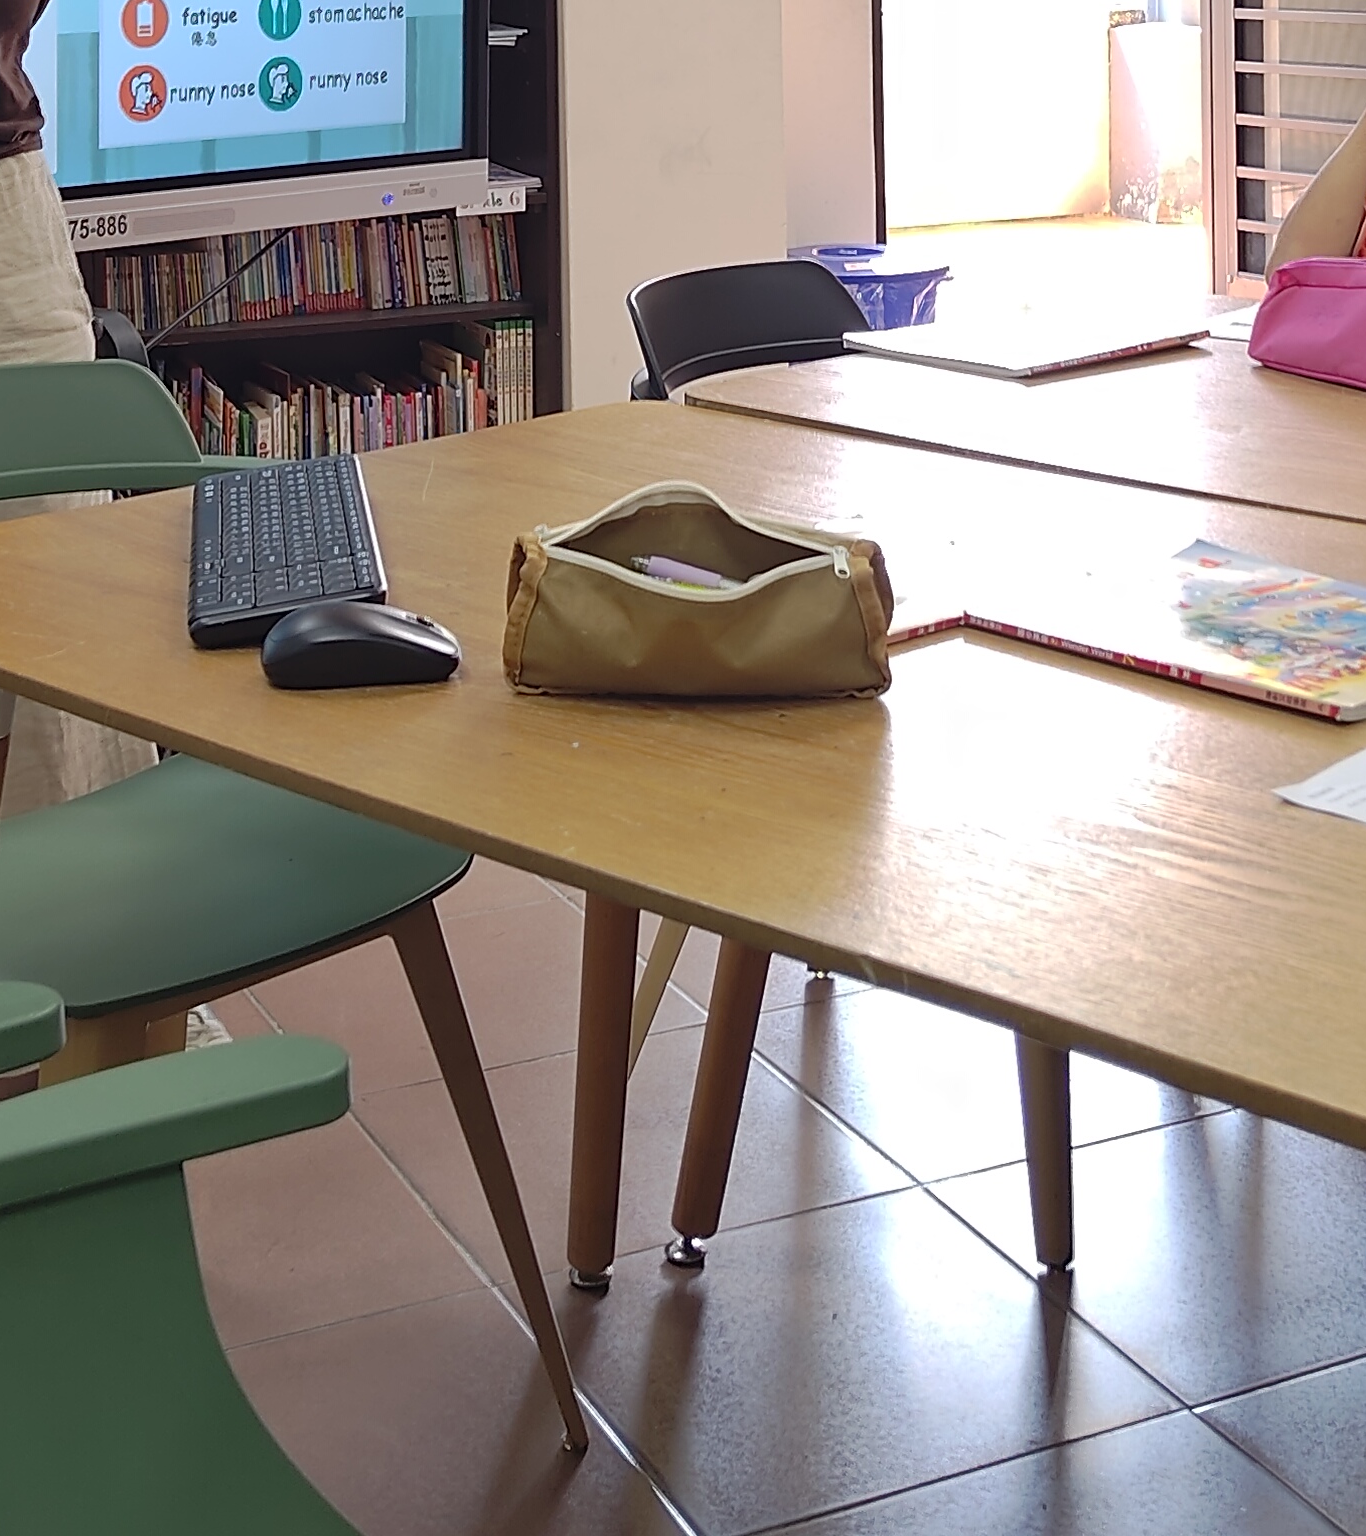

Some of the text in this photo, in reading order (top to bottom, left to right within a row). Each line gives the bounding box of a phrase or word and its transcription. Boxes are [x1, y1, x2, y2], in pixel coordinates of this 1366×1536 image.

[182, 7, 238, 30] fatigue
[308, 1, 405, 25] stomachache
[309, 67, 388, 91] runny nose
[170, 81, 256, 106] runny nose
[68, 215, 127, 241] 75-886
